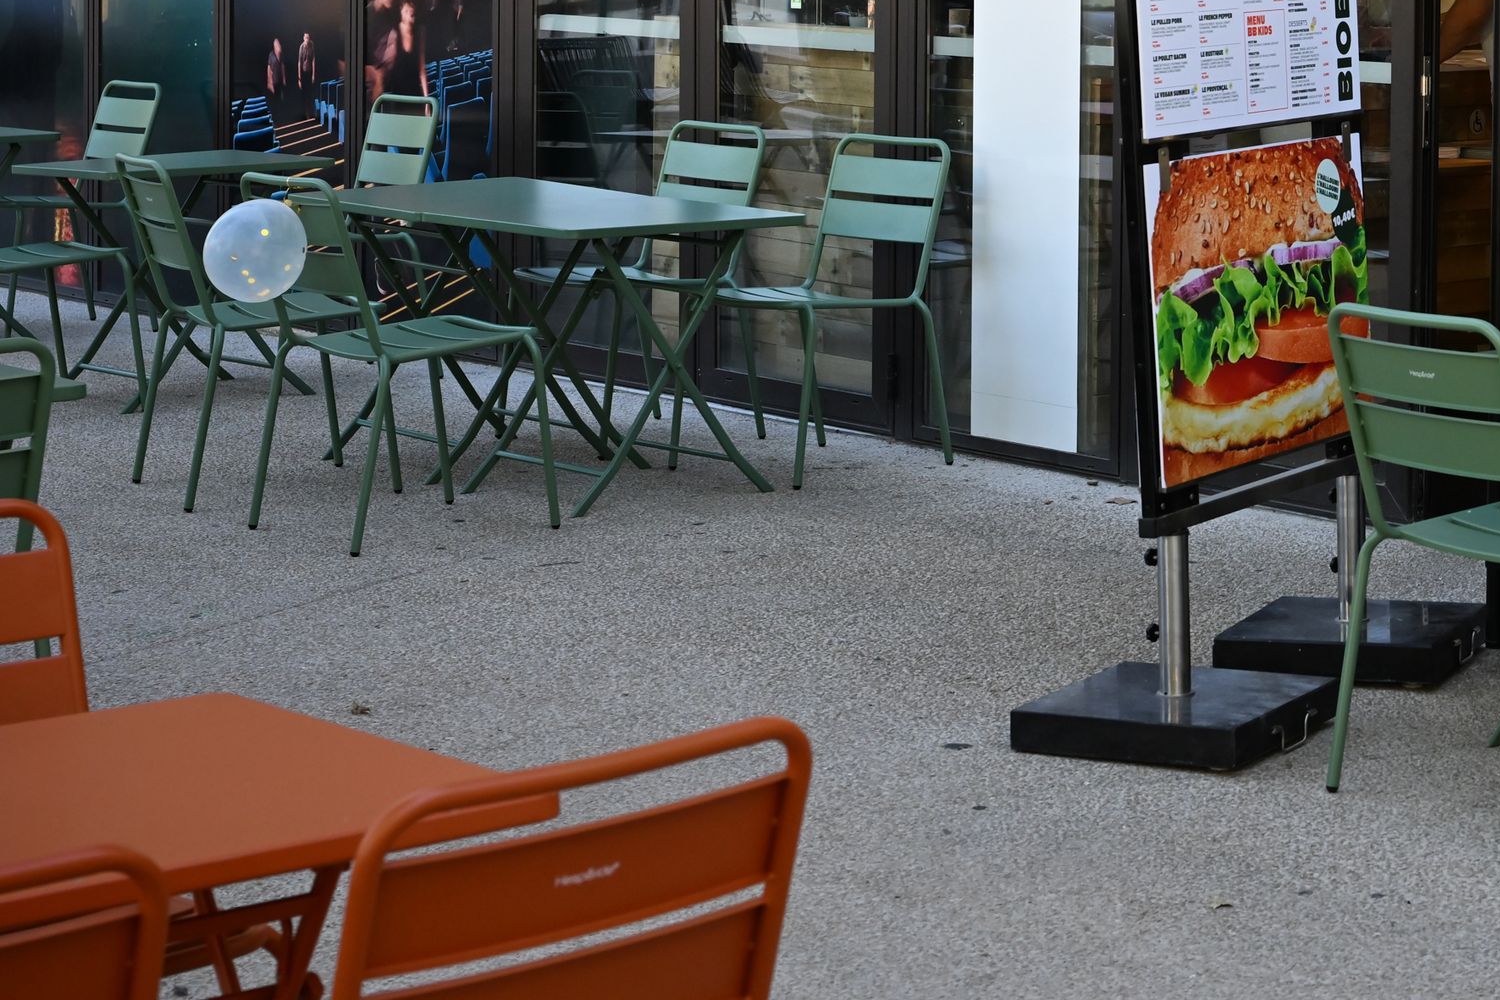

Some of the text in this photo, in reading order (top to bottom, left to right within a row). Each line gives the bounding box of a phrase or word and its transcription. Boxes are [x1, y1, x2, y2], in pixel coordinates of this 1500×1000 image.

[1247, 15, 1265, 25] MENU
[1248, 26, 1272, 36] BB KIDS
[1333, 208, 1356, 227] 10,40€
